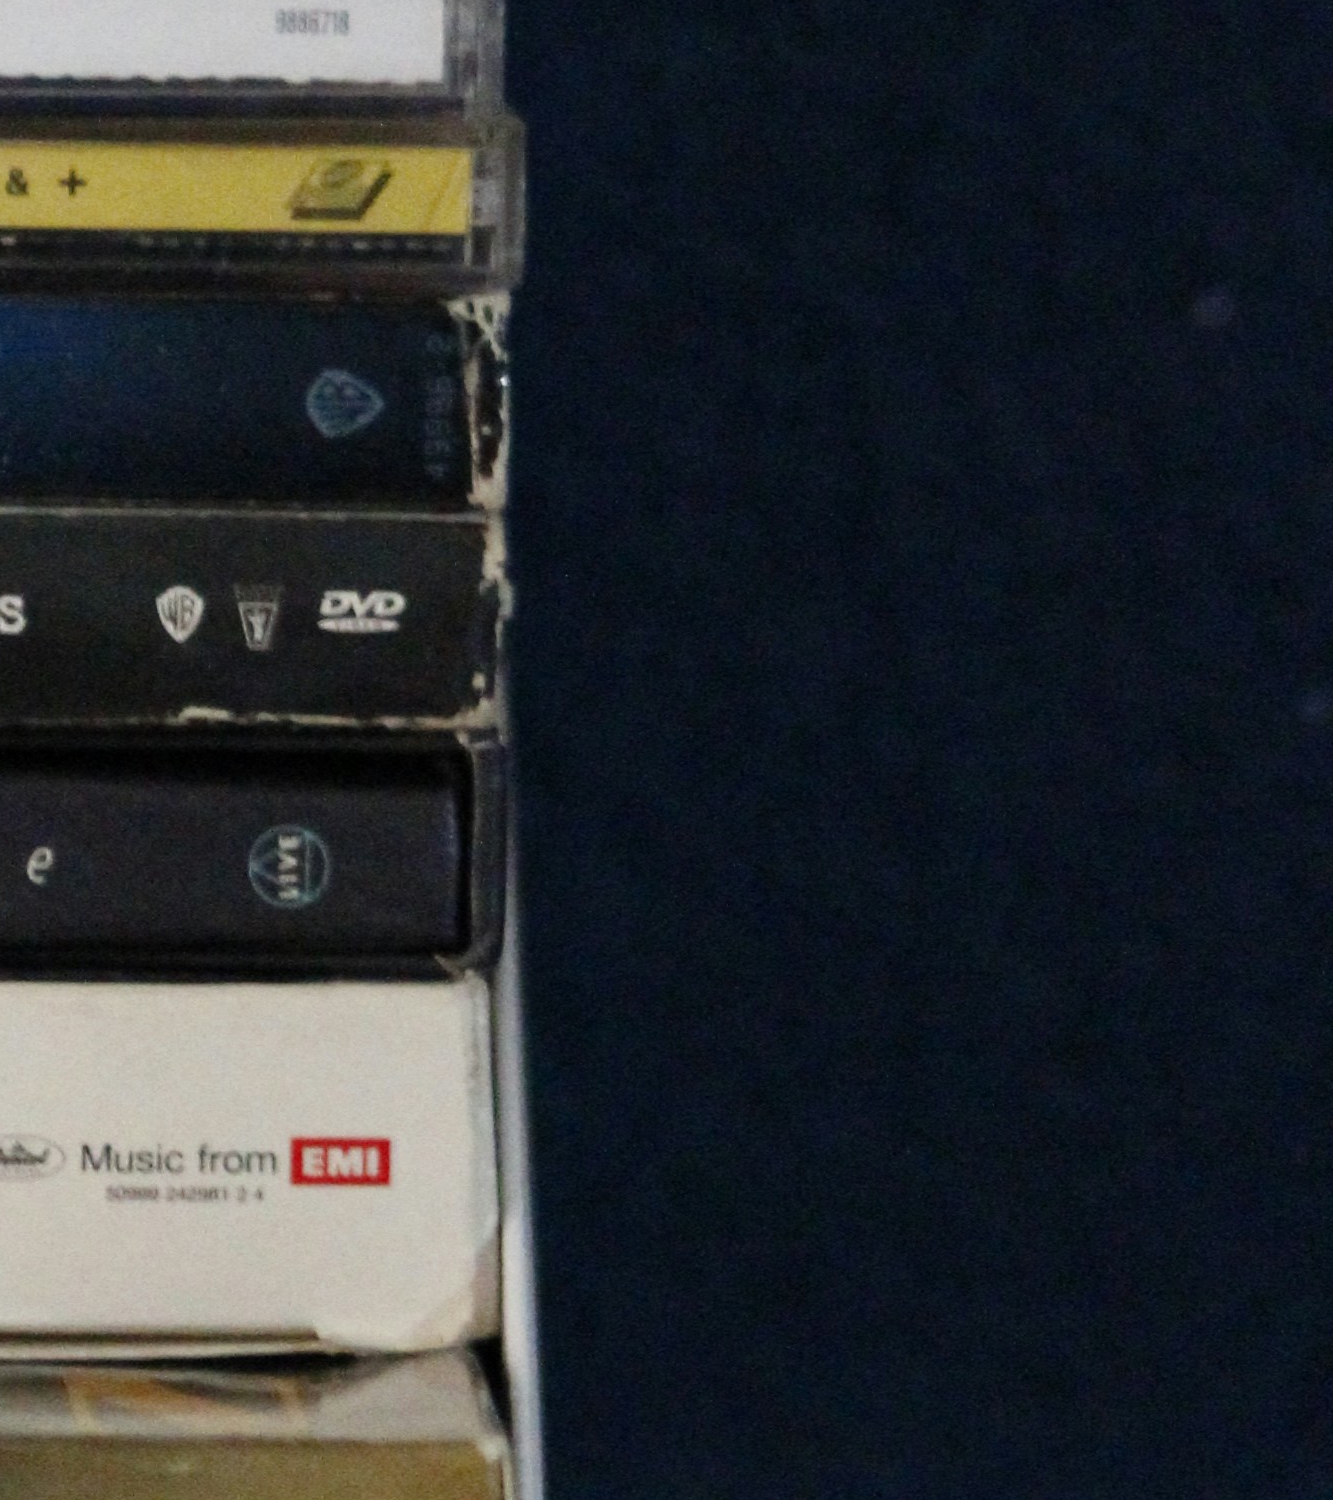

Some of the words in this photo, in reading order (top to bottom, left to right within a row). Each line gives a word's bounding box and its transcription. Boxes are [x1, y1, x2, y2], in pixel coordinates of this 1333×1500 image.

[4, 168, 31, 197] &
[321, 592, 407, 617] DVD
[80, 1143, 182, 1174] Music
[198, 1143, 277, 1173] from
[300, 1147, 379, 1176] EMI
